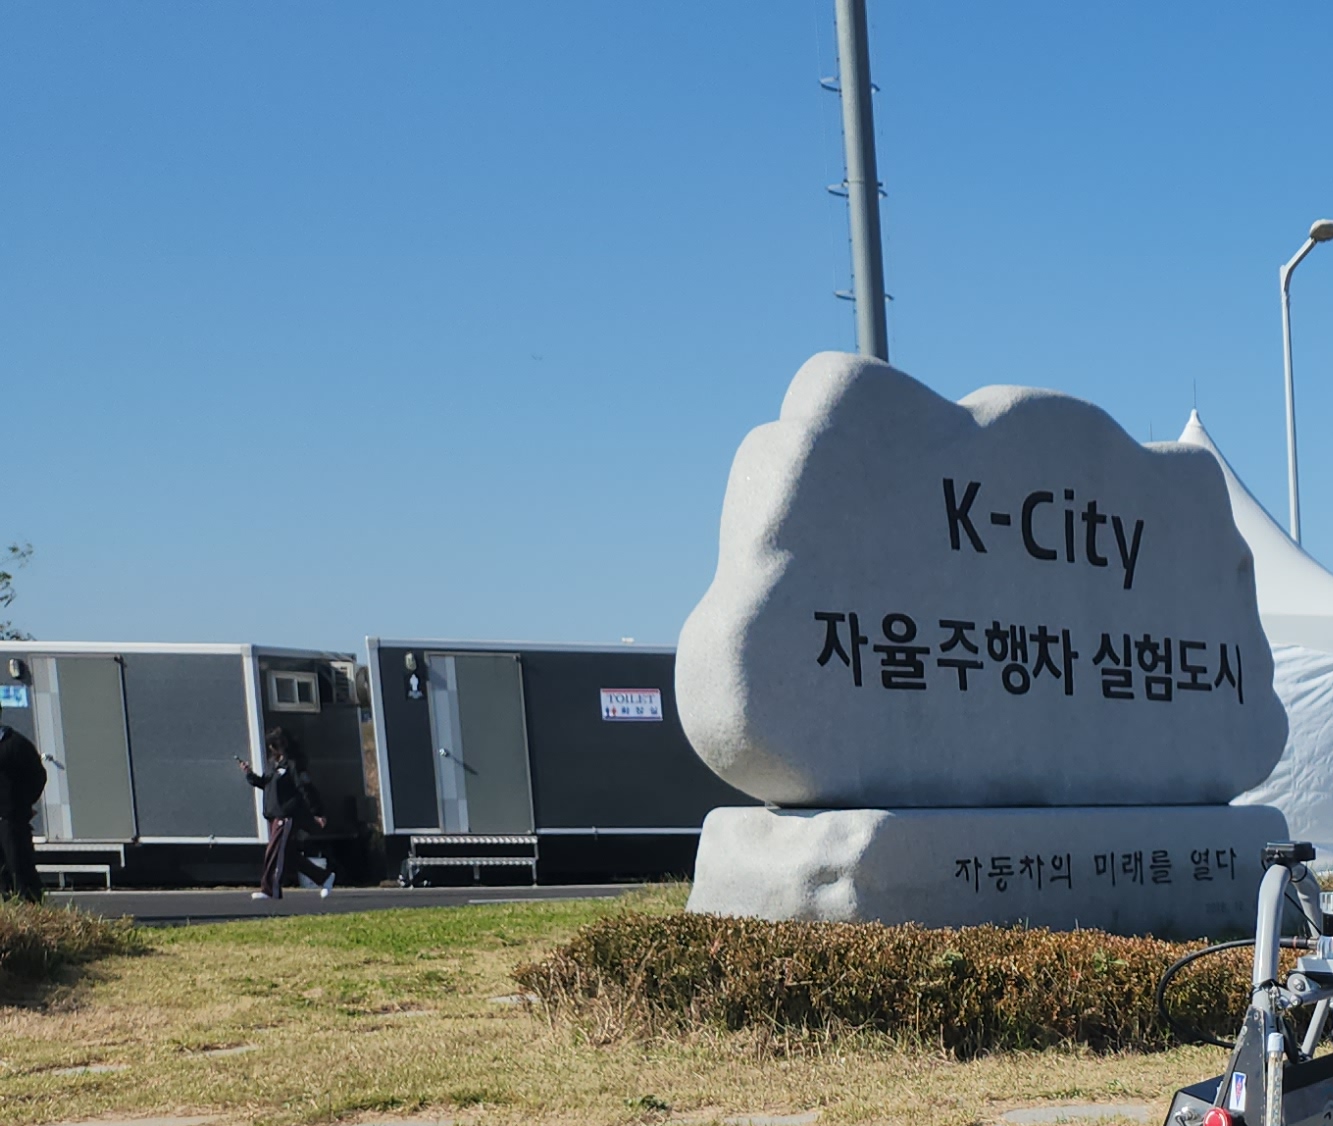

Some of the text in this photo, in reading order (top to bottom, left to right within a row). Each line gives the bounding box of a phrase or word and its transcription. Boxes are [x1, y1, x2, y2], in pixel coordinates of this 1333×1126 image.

[942, 478, 1144, 590] K-City
[814, 611, 1244, 704] 자율주행차 실험도시
[606, 693, 655, 703] TOILET
[955, 847, 1237, 893] 자동차의 미래를 열다
